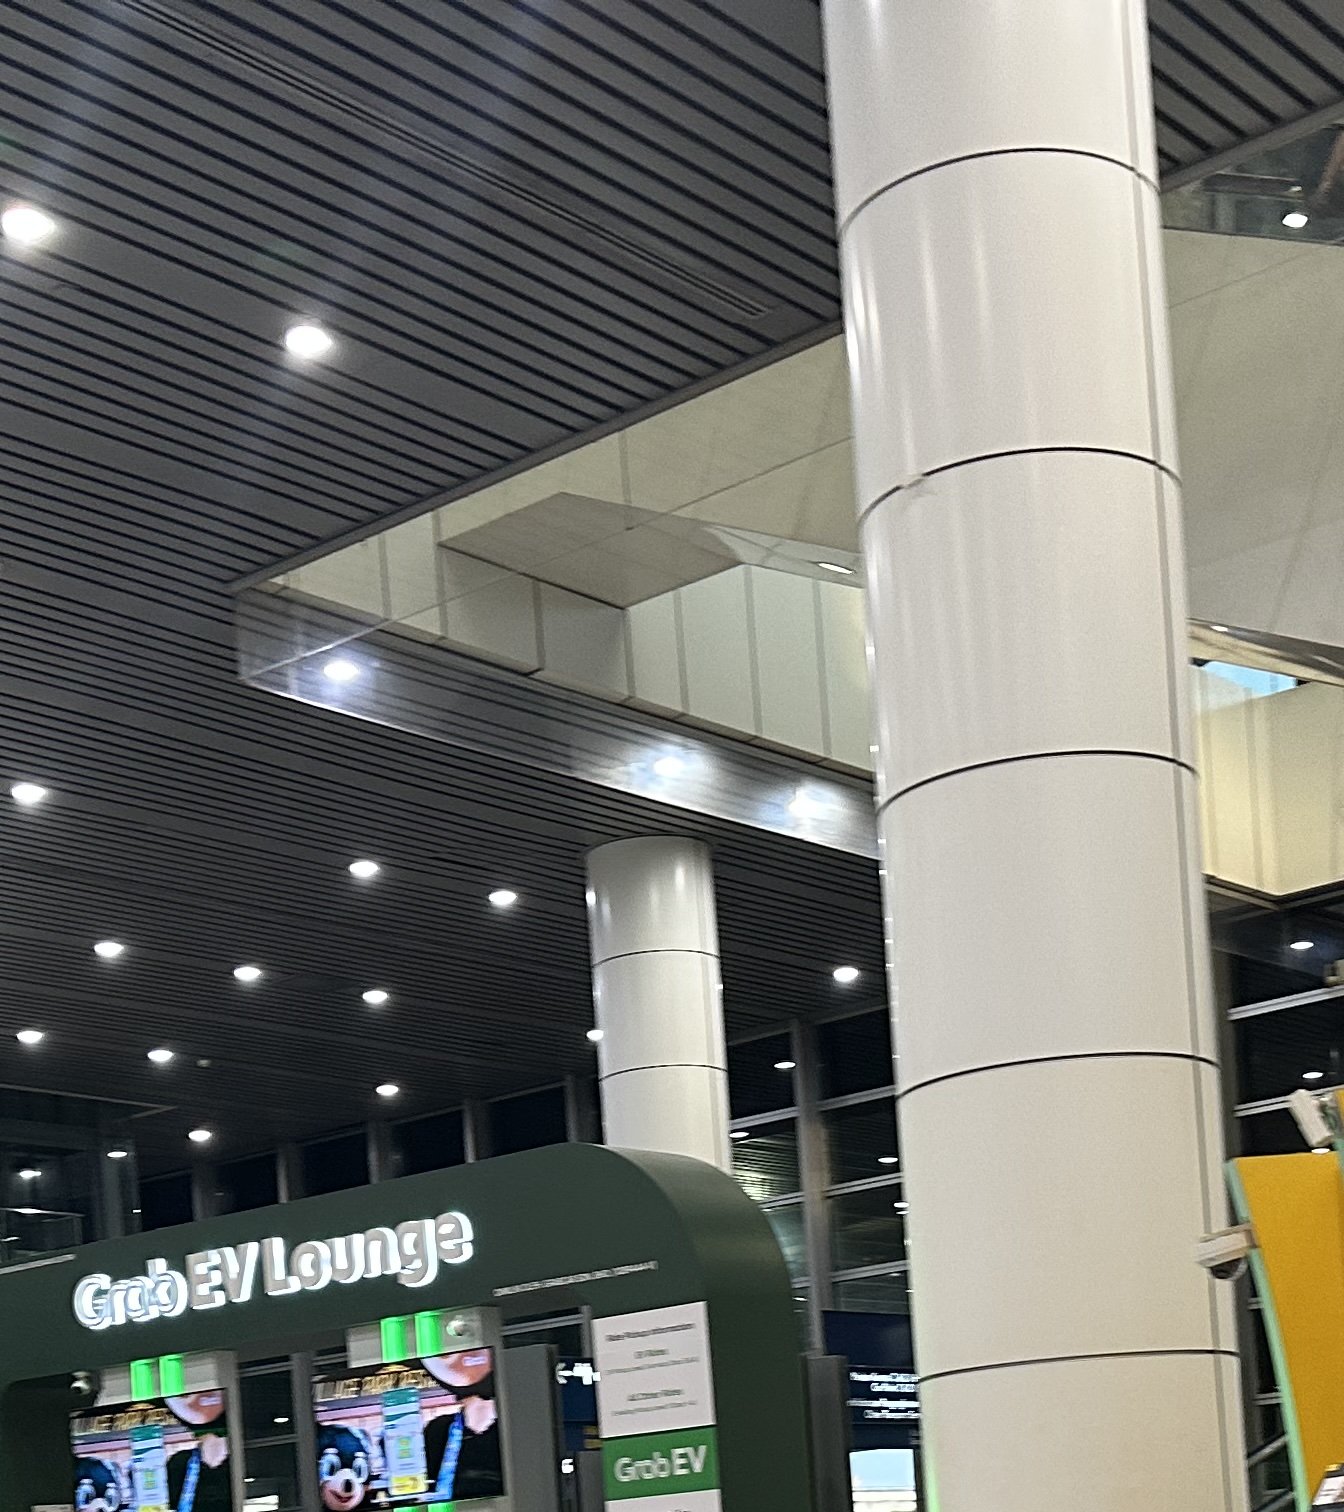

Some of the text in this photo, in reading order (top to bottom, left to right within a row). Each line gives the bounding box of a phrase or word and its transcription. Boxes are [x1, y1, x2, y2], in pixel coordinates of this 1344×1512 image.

[72, 1257, 188, 1331] Grab
[185, 1240, 260, 1311] EV
[261, 1211, 475, 1297] Lounge
[613, 1445, 707, 1482] Grab EV
